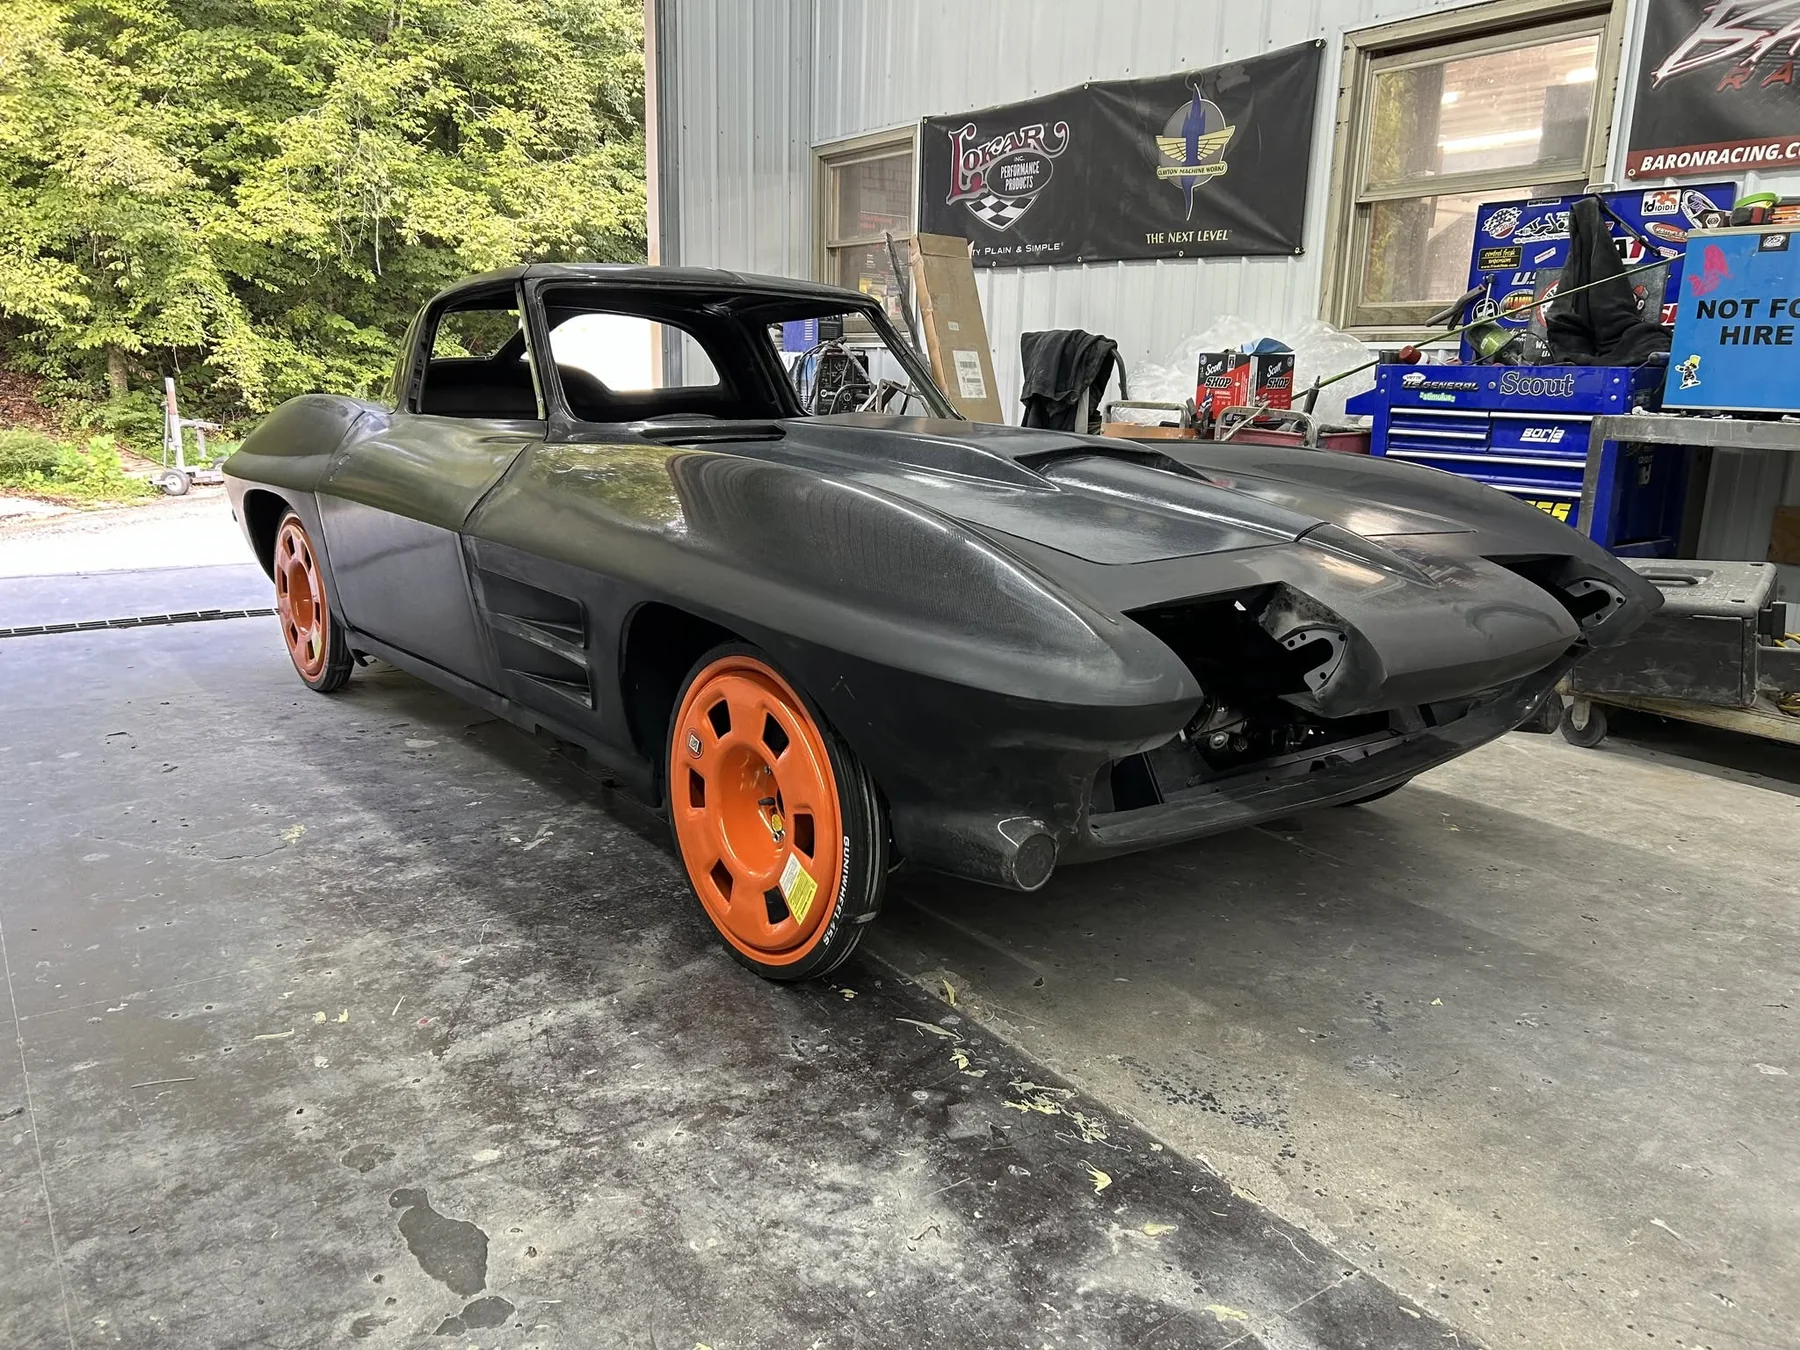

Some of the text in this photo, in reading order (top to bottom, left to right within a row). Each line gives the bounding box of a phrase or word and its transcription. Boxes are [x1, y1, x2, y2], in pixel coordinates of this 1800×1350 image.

[1000, 161, 1040, 179] PERFORMANCE
[1180, 166, 1205, 175] MACHINE
[1205, 164, 1225, 173] WORKS
[1004, 175, 1034, 192] PRODUCTS
[1145, 229, 1229, 244] THE NEXT LEVEL
[984, 246, 1012, 255] PLAIN
[1015, 245, 1022, 254] &
[1025, 242, 1061, 253] SIMPLE
[1696, 298, 1760, 319] NOT
[1719, 325, 1795, 345] HIRE
[1204, 376, 1232, 389] SHOP
[1266, 377, 1290, 390] SHOP
[1500, 371, 1575, 397] Scout
[834, 836, 850, 919] GUNIWHEEL
